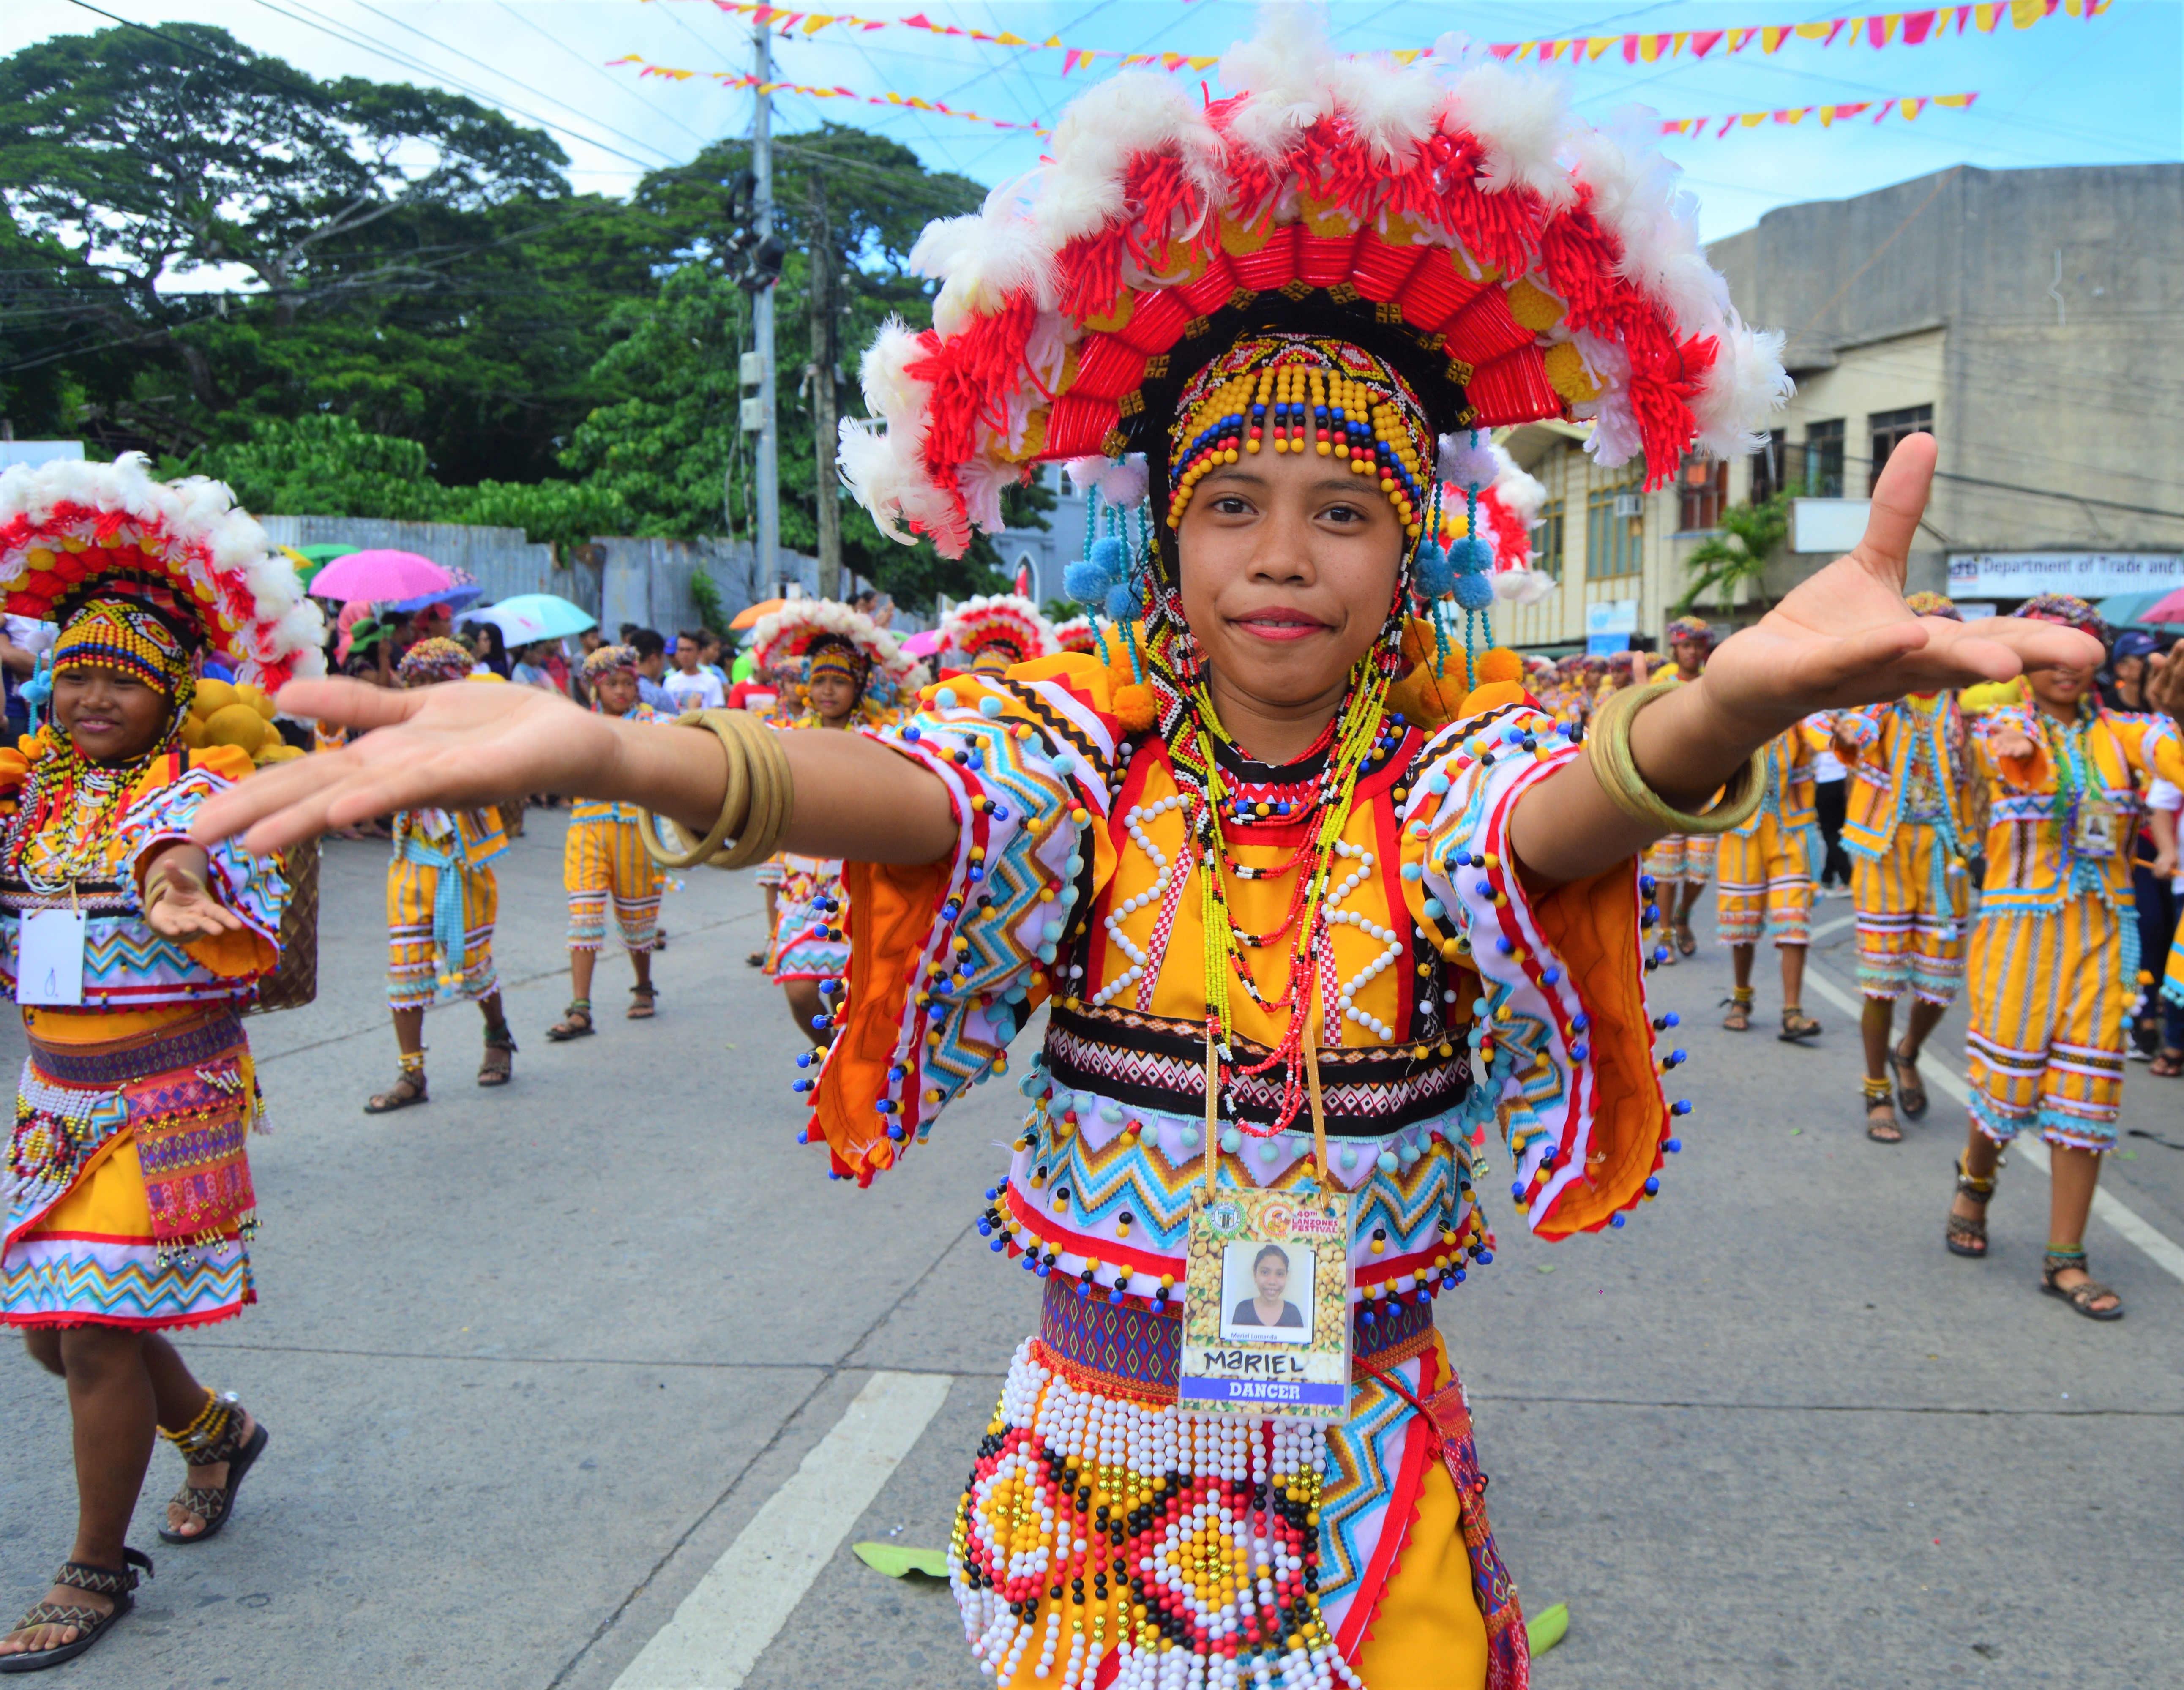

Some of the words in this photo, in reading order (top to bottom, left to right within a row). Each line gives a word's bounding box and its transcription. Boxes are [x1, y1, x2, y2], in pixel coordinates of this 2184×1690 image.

[1985, 556, 2071, 578] Department
[2078, 555, 2092, 572] of
[2100, 555, 2142, 572] Trade
[2149, 555, 2176, 572] and
[1292, 1223, 1338, 1233] FESTIVAL
[1229, 1382, 1300, 1400] DANCER
